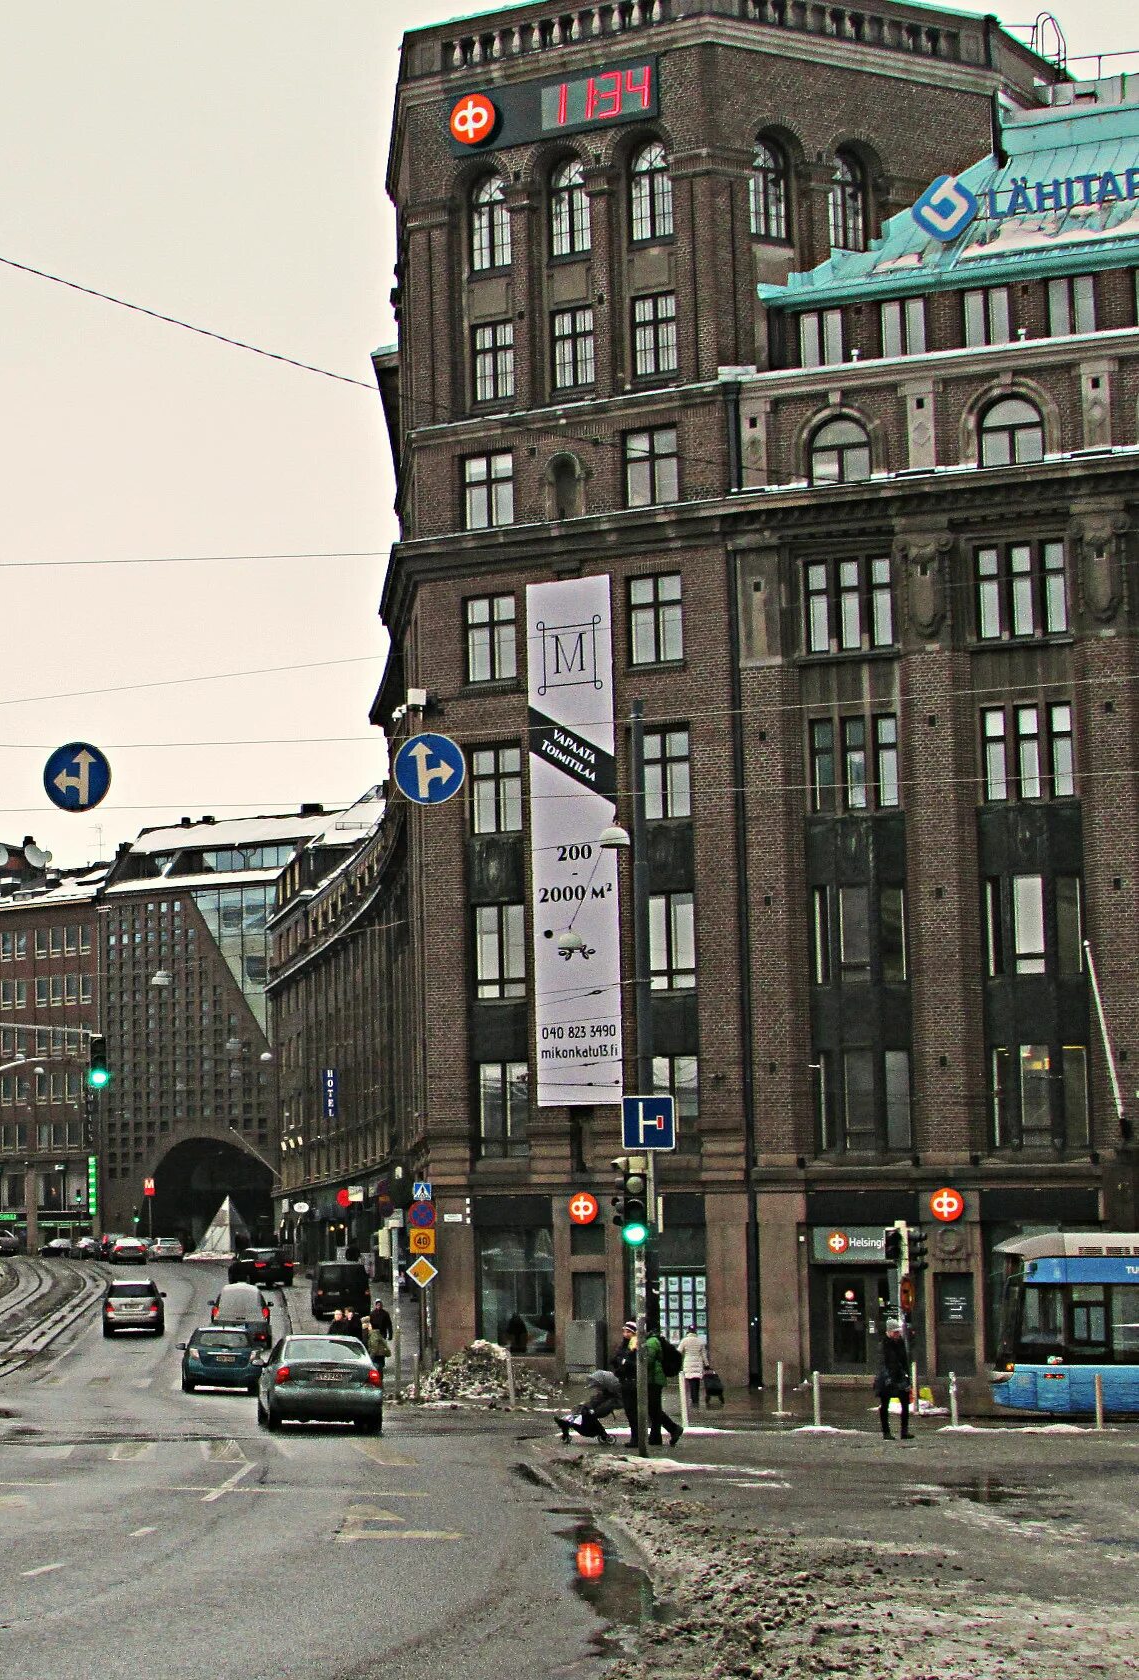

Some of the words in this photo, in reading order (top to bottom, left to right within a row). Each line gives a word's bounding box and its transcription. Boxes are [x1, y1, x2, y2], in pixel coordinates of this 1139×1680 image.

[551, 631, 587, 675] M
[553, 728, 597, 765] VAPAATA
[541, 739, 597, 782] TOIMITILAA
[556, 843, 593, 862] 200
[538, 884, 587, 904] 2000
[541, 1026, 564, 1040] 040
[568, 1025, 587, 1039] 823
[590, 1023, 617, 1038] 3490
[541, 1043, 619, 1060] mikonkatu13.fi
[327, 1069, 335, 1117] HOTEL
[416, 1236, 429, 1246] 40
